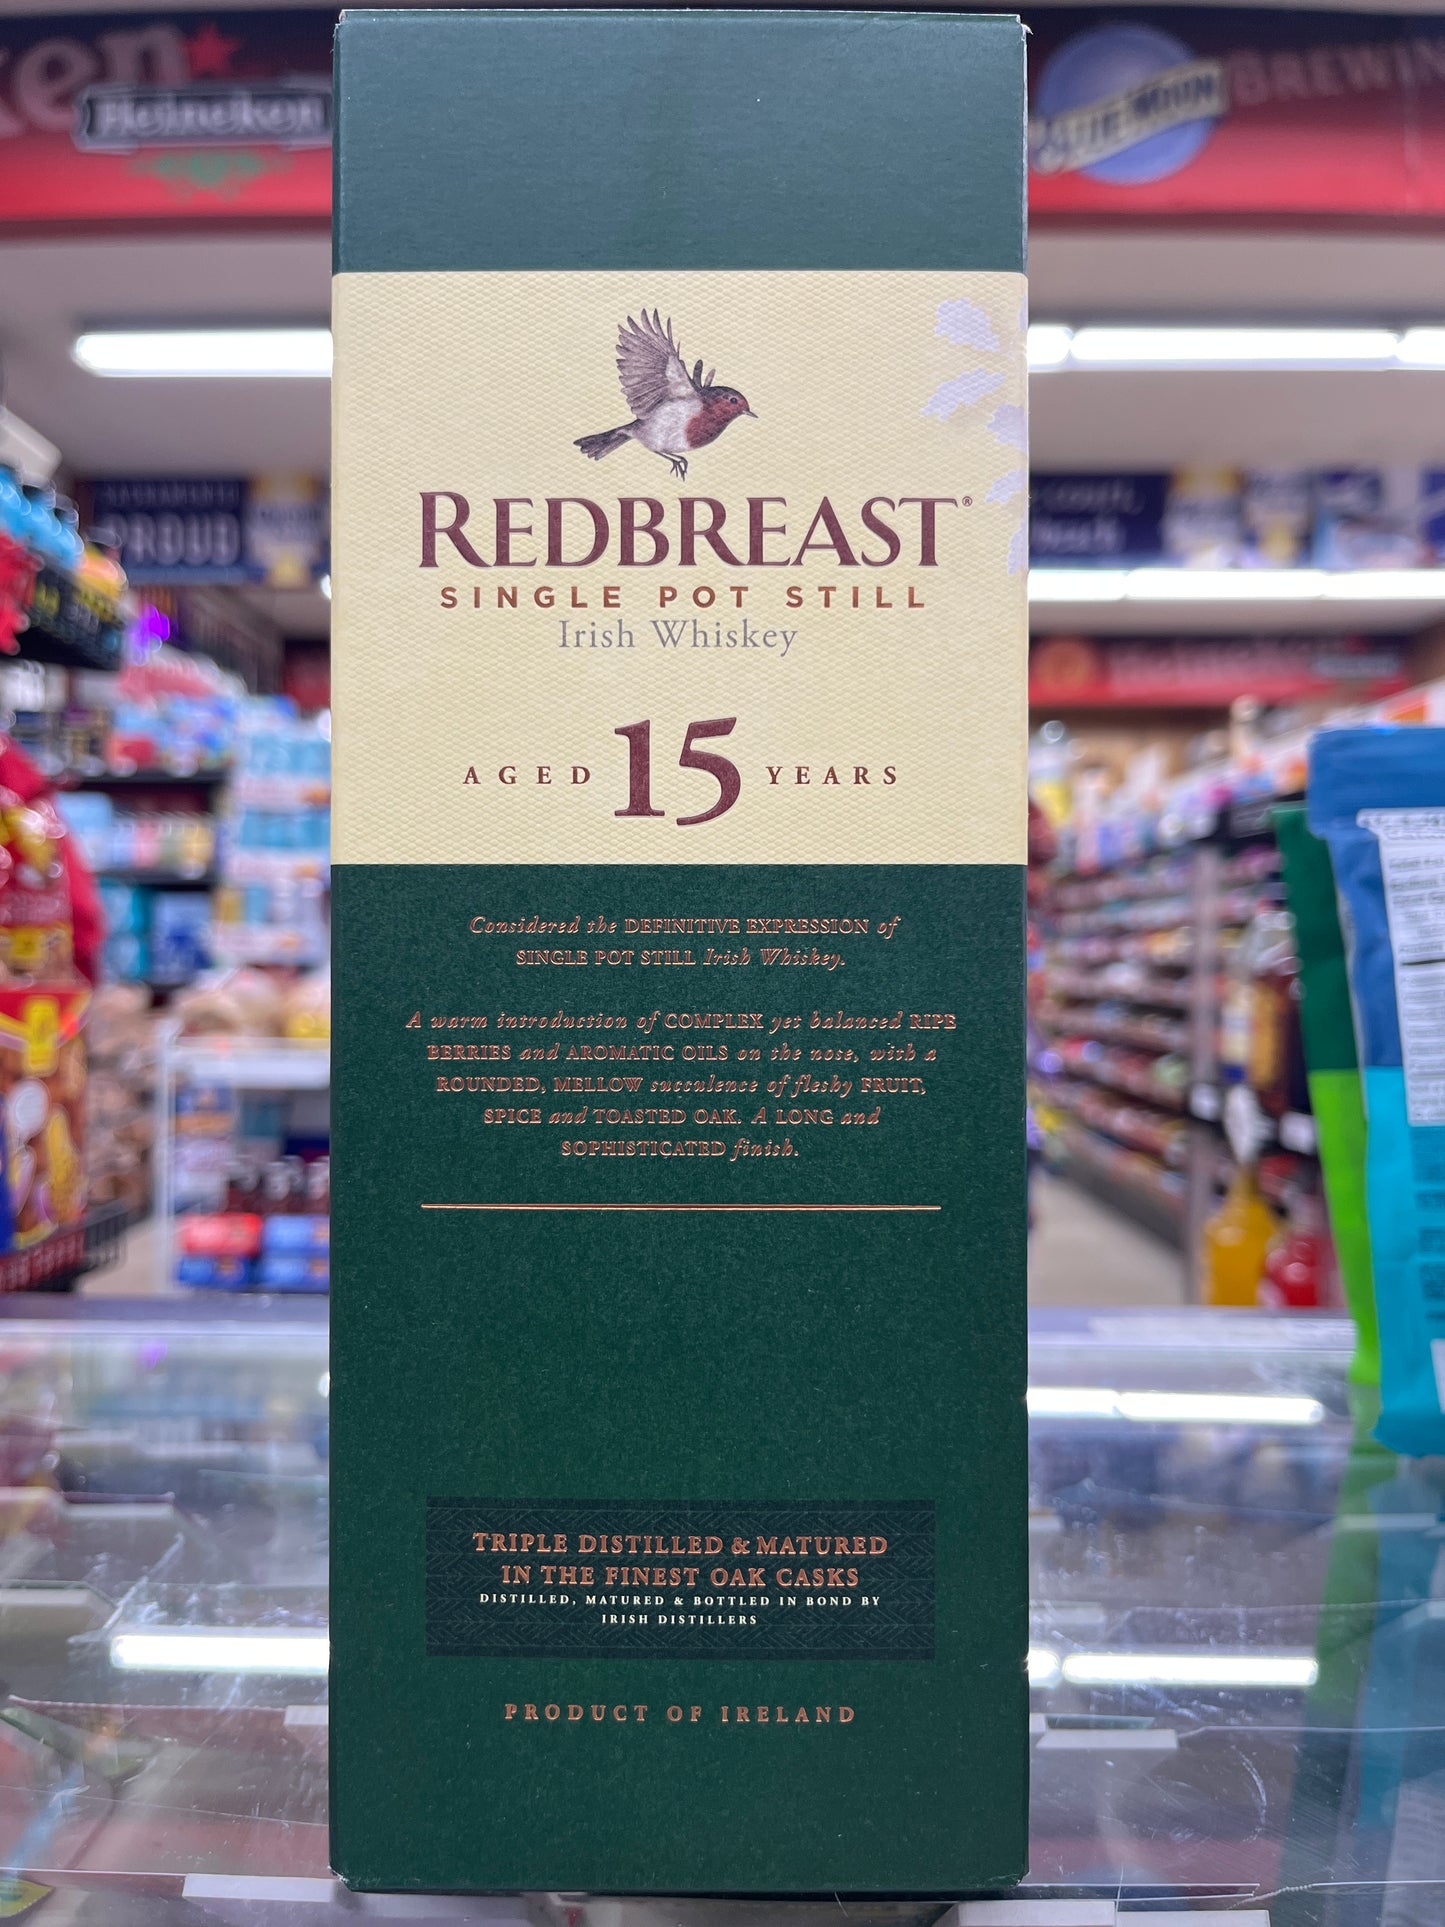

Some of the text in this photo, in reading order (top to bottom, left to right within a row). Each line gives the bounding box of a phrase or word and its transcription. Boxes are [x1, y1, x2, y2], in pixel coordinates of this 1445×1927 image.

[0, 25, 190, 137] en
[95, 90, 325, 138] Heineken
[419, 491, 959, 568] REDBREAST
[439, 586, 926, 609] SINGLE POT STILL
[558, 619, 799, 657] Irish Whiskey
[462, 716, 898, 826] AGED 15 YEARS
[469, 915, 901, 940] Considered the DEFINITIVE EXPRESSION of
[516, 947, 846, 971] SINGLE POT STILL Irish Whiskey.
[405, 1010, 957, 1034] A warm introduction of COMPLEX yet balanced RIPE
[427, 1043, 938, 1064] BERRIES and AROMATIC OILS on the nose, with a
[437, 1074, 926, 1098] ROUNDED, MELLOW succulence of fleshy FRUIT,
[483, 1106, 882, 1125] SPICE and TOASTED OAK. A LONG and
[561, 1138, 800, 1162] SOPHISTICATED finish.
[472, 1532, 569, 1554] TRIPLE
[578, 1534, 724, 1556] DISTILLED
[501, 1565, 860, 1589] IN THE FINEST OAK CASKS
[479, 1593, 881, 1608] DISTILLED, MATURED & BOTTLED IN BOND BY
[601, 1614, 758, 1625] IRISH DISTILLERS
[505, 1703, 856, 1724] PRODUCT OF IRELAND
